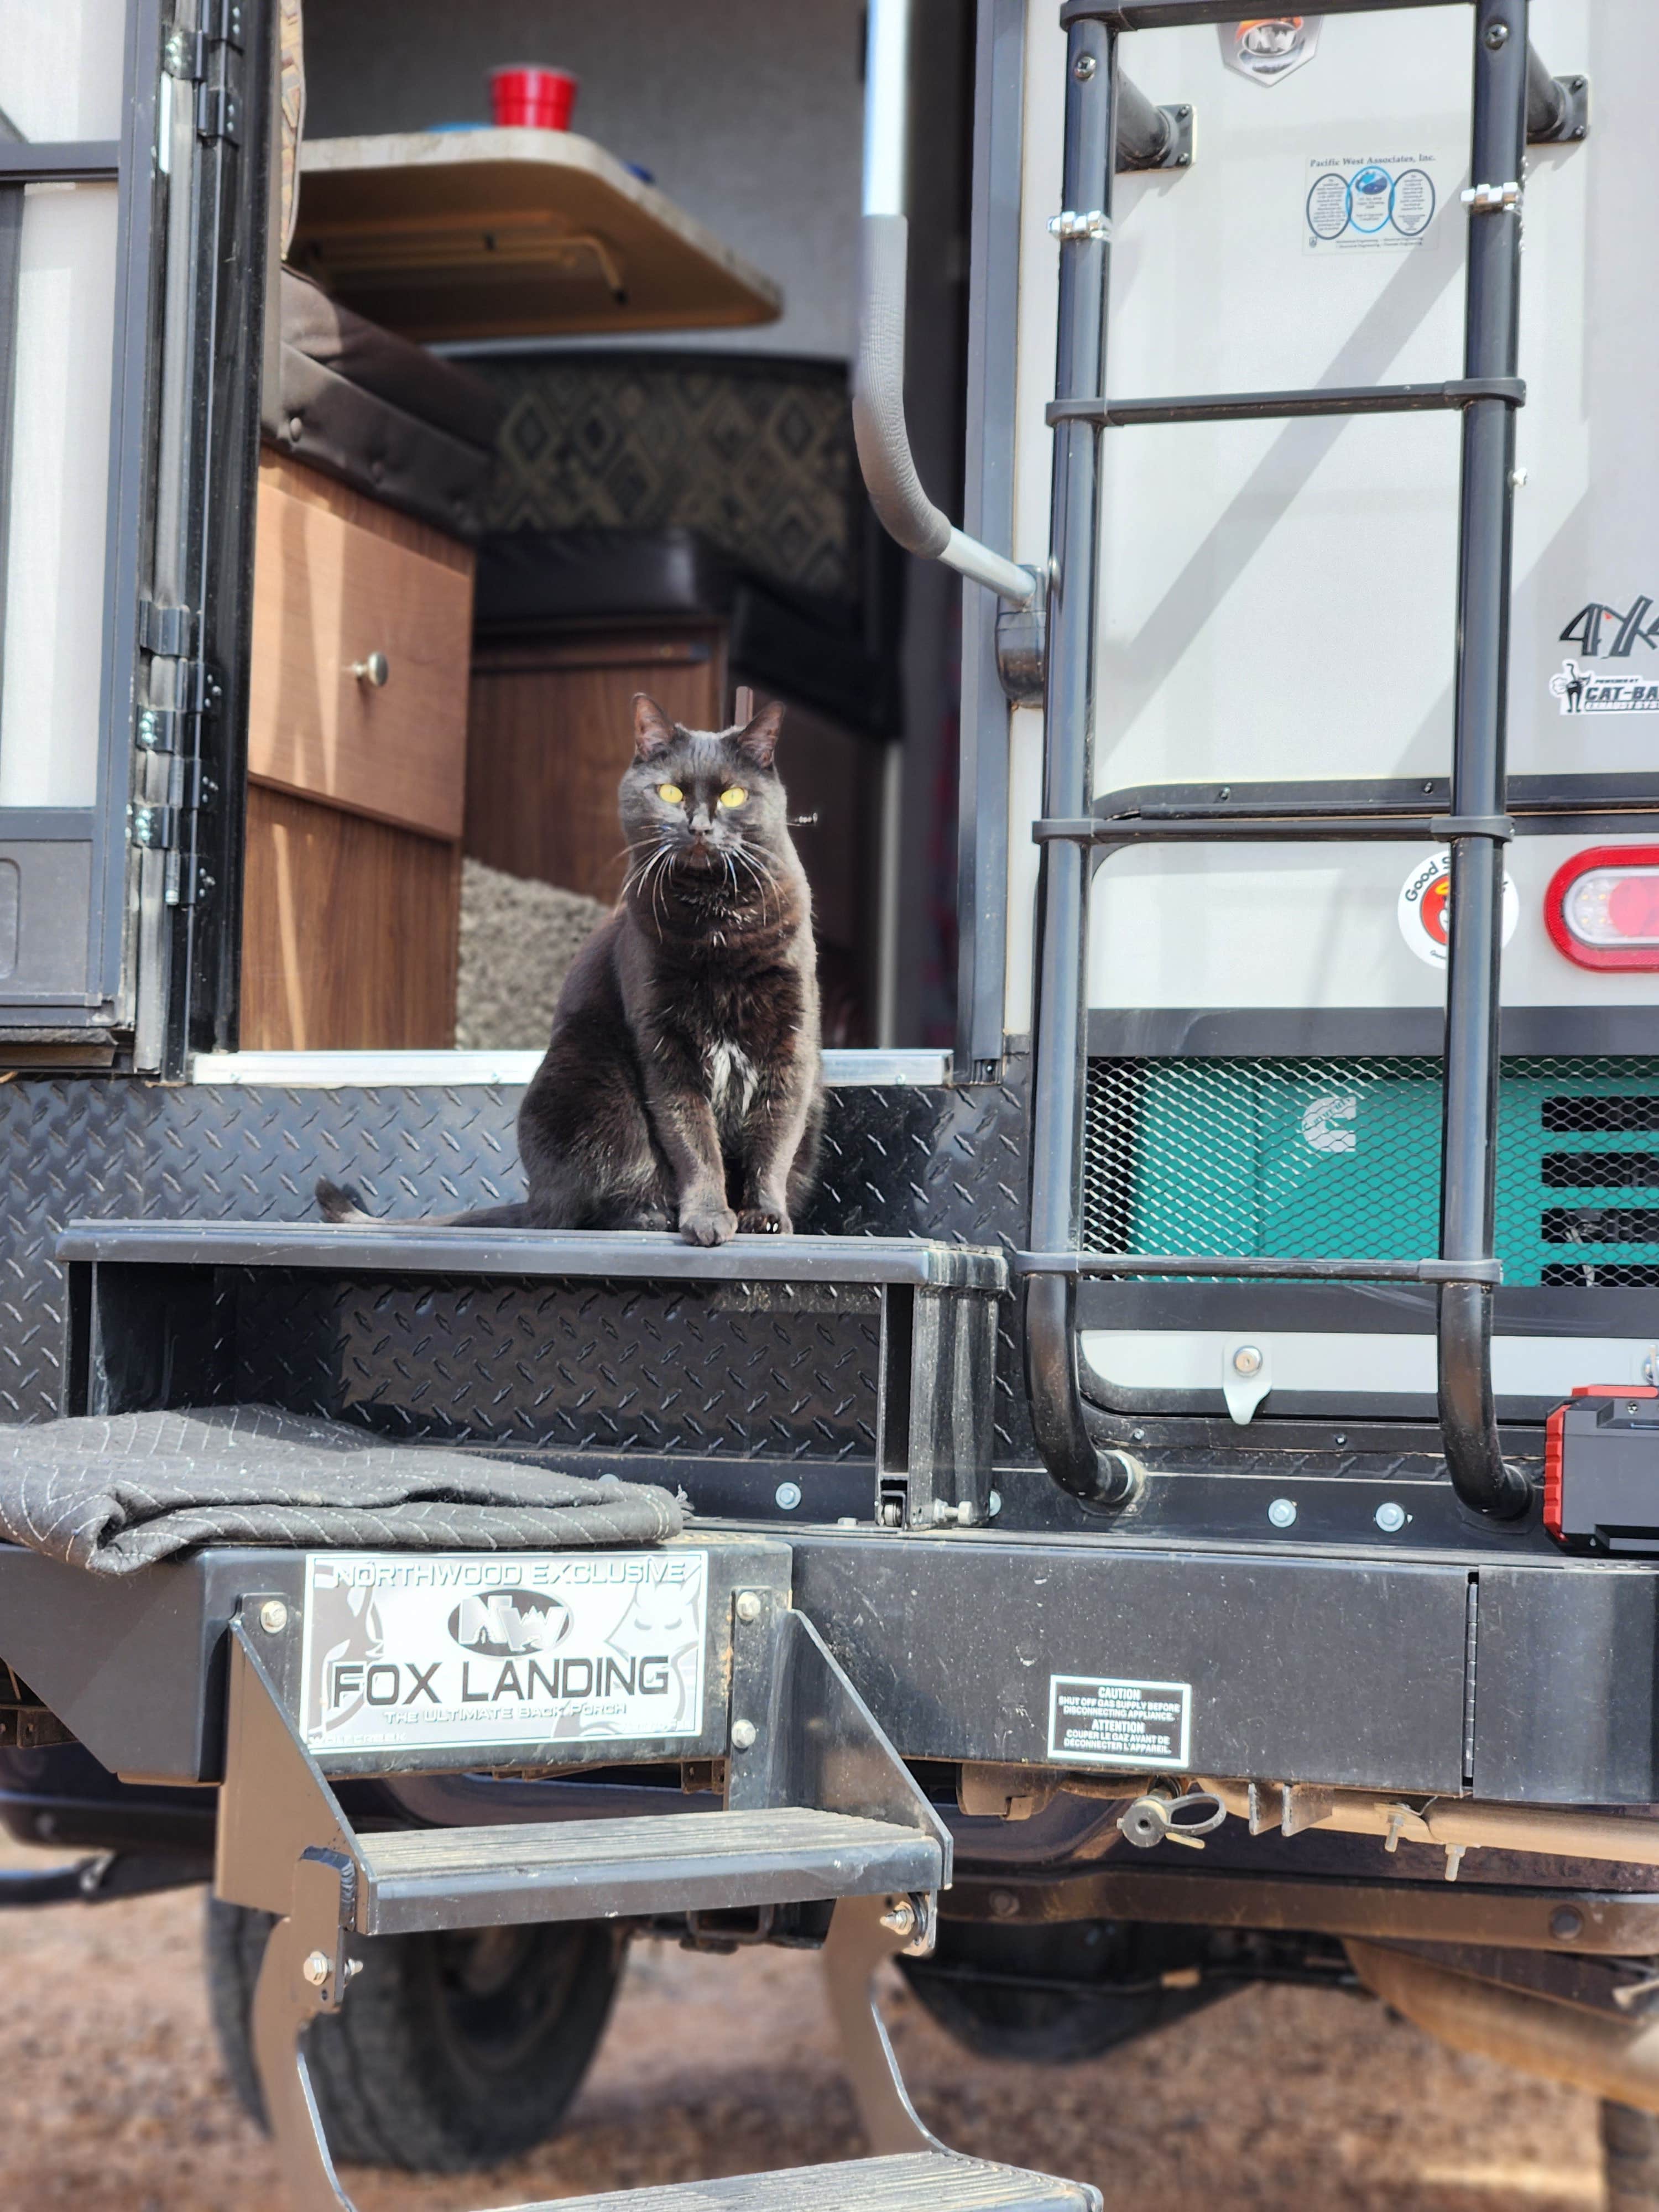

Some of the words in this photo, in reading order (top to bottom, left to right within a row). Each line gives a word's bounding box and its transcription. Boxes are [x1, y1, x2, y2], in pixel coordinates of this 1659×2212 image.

[1367, 156, 1416, 164] Associates,
[1419, 153, 1436, 161] Inc.
[1405, 860, 1439, 901] Good
[334, 1563, 523, 1588] NORTHWOOD
[532, 1559, 686, 1584] EXCLUSIVE
[333, 1662, 442, 1708] FOX
[462, 1656, 668, 1702] LANDING
[1098, 1686, 1142, 1700] CAUTION
[1058, 1695, 1080, 1706] SHUT
[1081, 1697, 1097, 1707] OFF
[1097, 1698, 1115, 1708] GAS
[1115, 1699, 1147, 1710] SUPPLY
[1147, 1700, 1181, 1713] BEFORE
[384, 1712, 419, 1724] THE
[424, 1707, 514, 1723] ULTIMATE
[517, 1704, 566, 1718] BACK
[569, 1702, 627, 1716] PORCH
[1063, 1706, 1128, 1718] DISCONNECTING
[1128, 1709, 1176, 1722] APPLIANCE.
[1091, 1718, 1146, 1734] ATTENTION
[1066, 1729, 1100, 1740] COUPER
[1100, 1731, 1112, 1741] LE
[1112, 1732, 1130, 1743] GAZ
[1129, 1733, 1157, 1745] AVANT
[1157, 1735, 1171, 1745] DE
